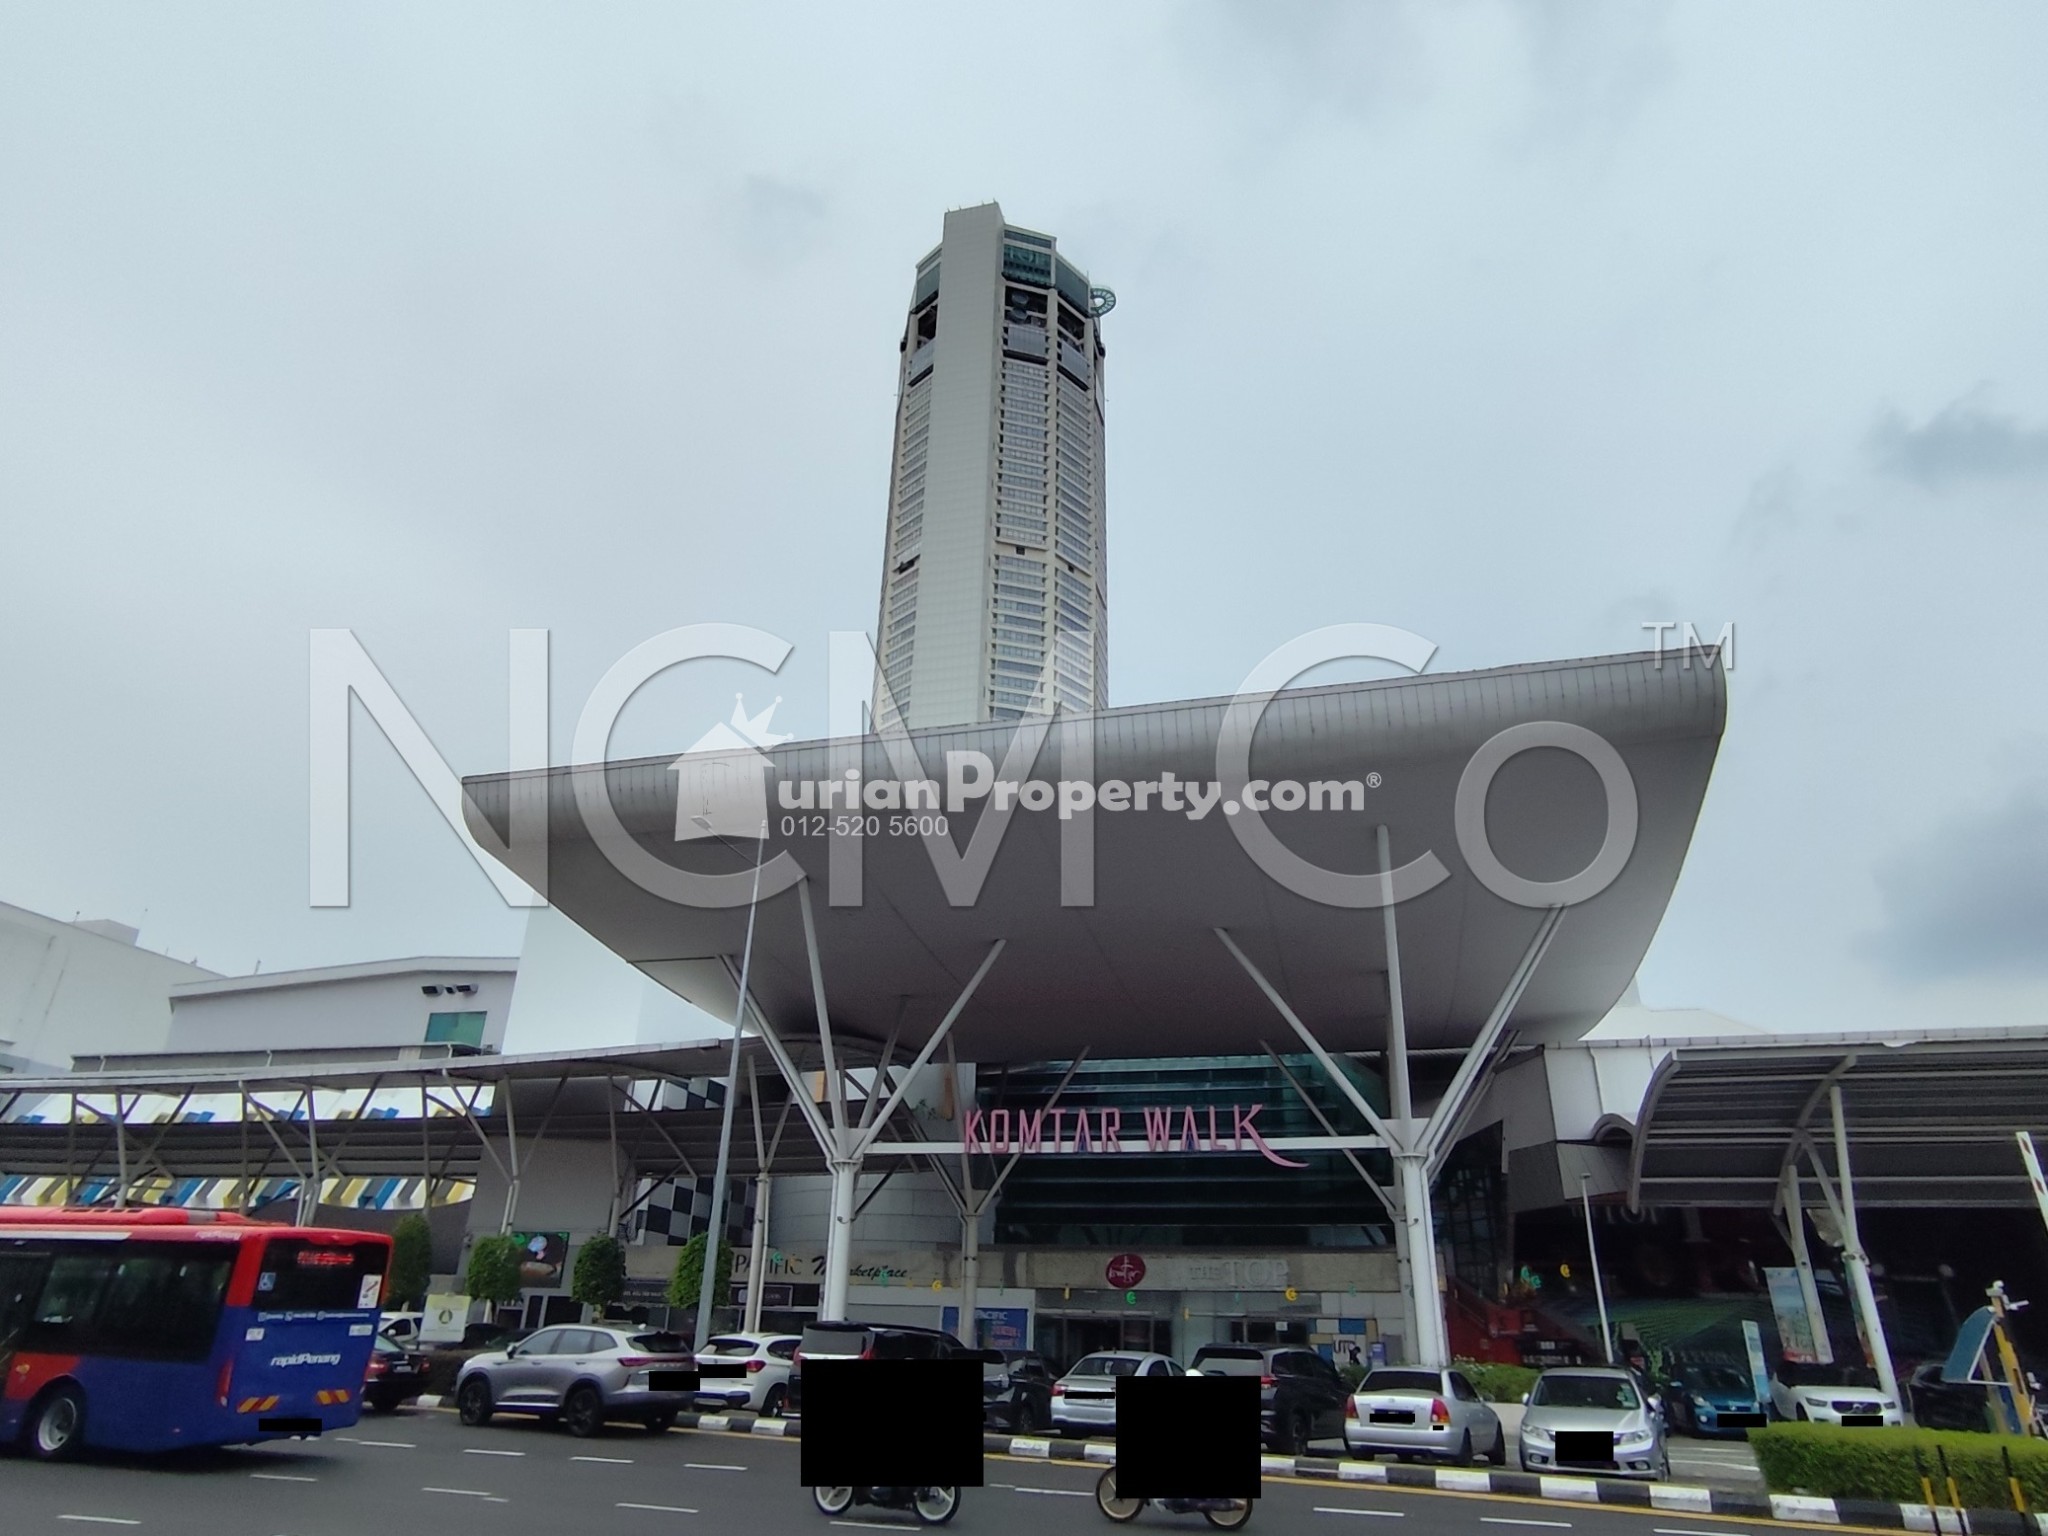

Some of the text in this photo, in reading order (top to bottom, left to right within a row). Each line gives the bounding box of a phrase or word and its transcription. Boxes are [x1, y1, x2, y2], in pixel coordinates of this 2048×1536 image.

[964, 1103, 1310, 1168] KOMTAR WALK
[1225, 1259, 1291, 1287] TOP
[270, 1352, 342, 1368] rapidPenang
